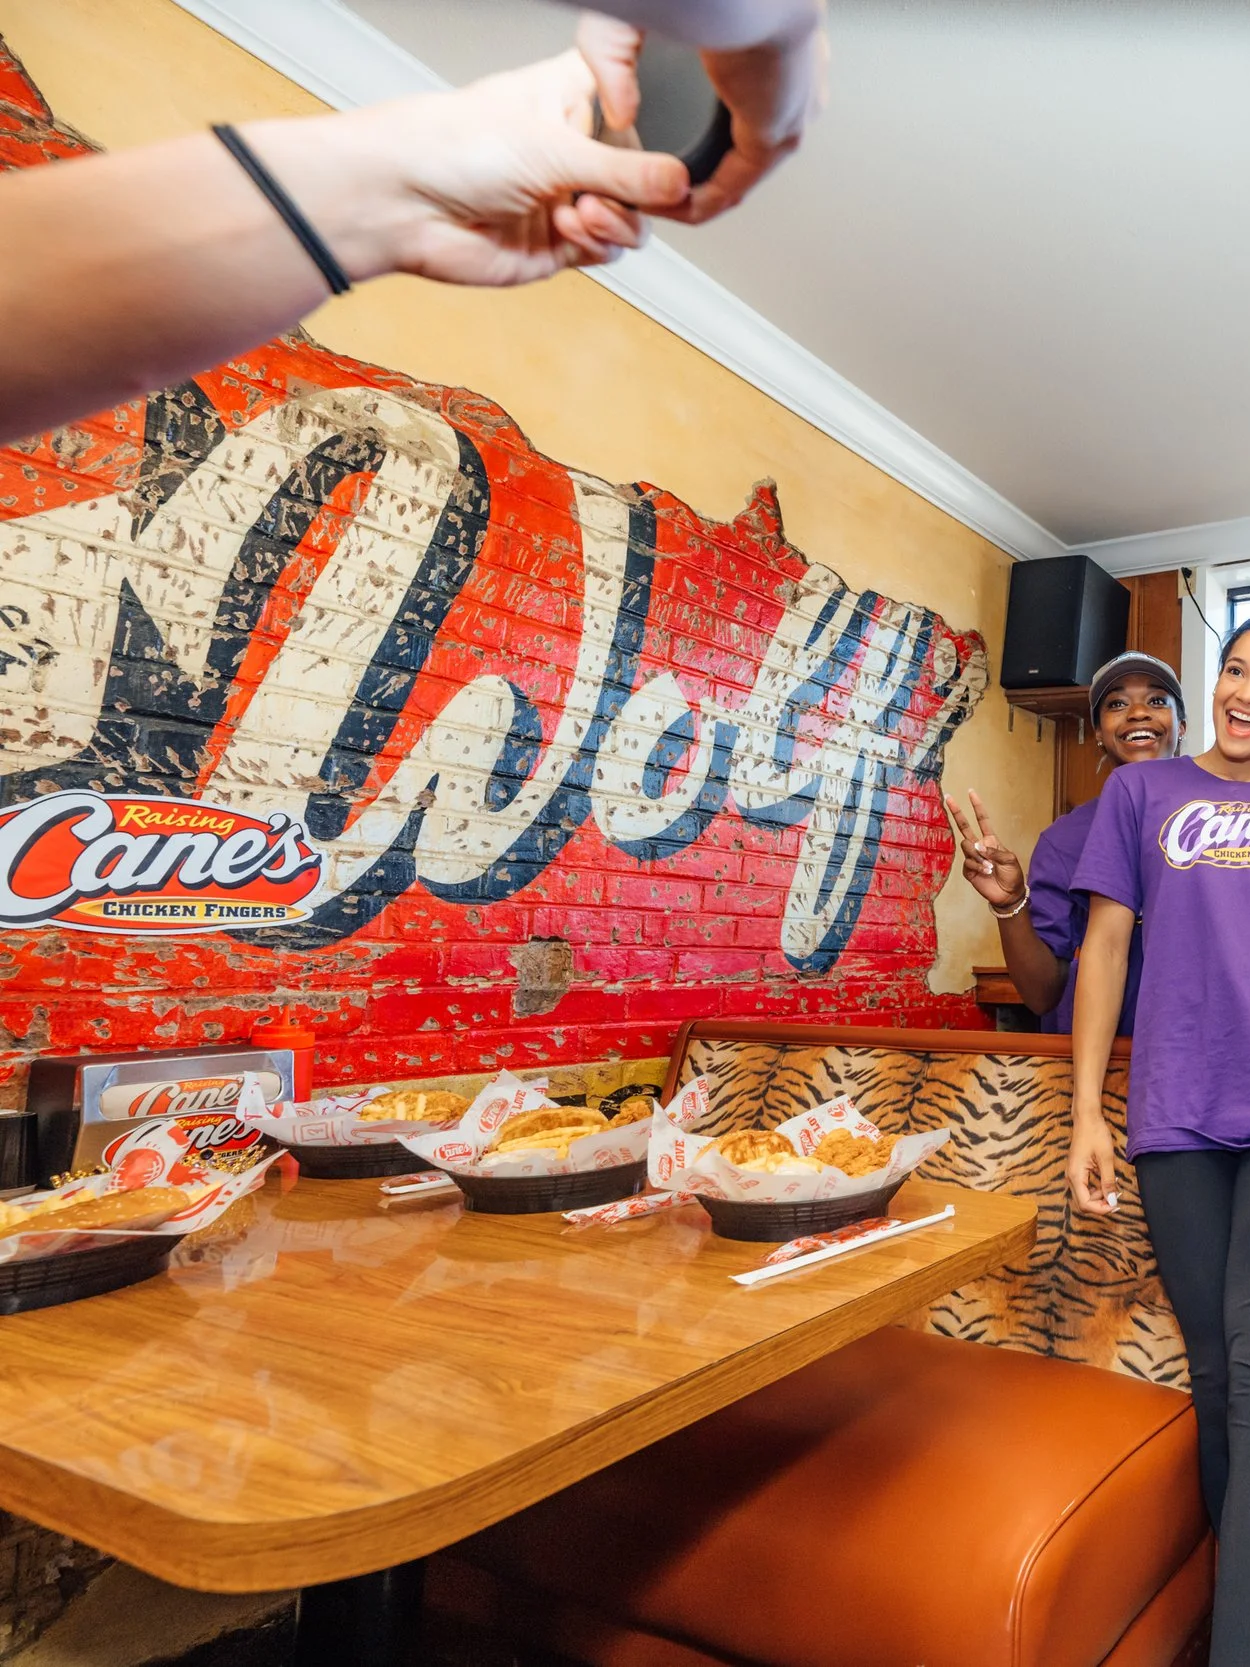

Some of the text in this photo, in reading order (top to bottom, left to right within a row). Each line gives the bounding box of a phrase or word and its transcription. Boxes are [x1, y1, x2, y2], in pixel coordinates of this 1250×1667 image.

[118, 804, 236, 836] Raising
[0, 801, 323, 918] Cane's
[102, 901, 287, 920] CHICKEN FINGERS
[134, 1076, 244, 1118] Cane'
[183, 1079, 225, 1091] Raising
[512, 1089, 527, 1110] LOVE
[675, 1140, 685, 1169] LOVE
